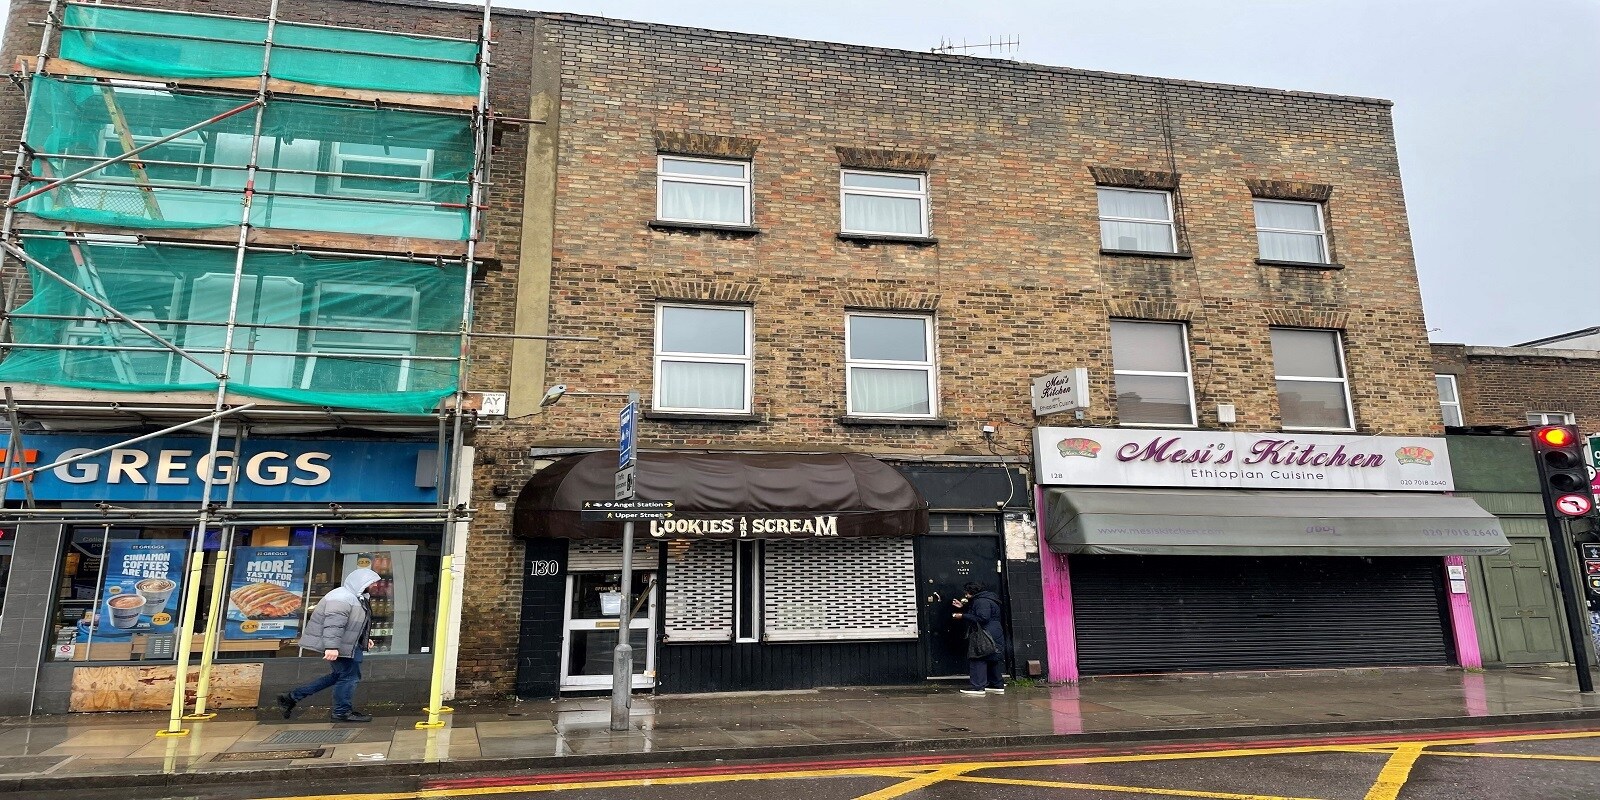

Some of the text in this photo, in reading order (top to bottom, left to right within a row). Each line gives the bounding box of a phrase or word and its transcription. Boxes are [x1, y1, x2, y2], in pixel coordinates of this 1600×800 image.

[484, 396, 501, 405] AY
[1116, 435, 1387, 468] Mesi's Kitchen
[53, 447, 333, 487] GREGGS
[1191, 468, 1324, 481] Ethiopian Cuisine
[650, 515, 838, 538] COOKIES AND SCREAM
[1422, 529, 1499, 537] 020 7018 2640
[123, 552, 171, 561] CINNAMON
[122, 561, 169, 572] COFFEES
[247, 560, 294, 573] MORE
[531, 559, 559, 576] 130
[121, 568, 168, 579] ARE BACK
[246, 571, 293, 581] TASTY FOR
[266, 579, 291, 588] MONEY
